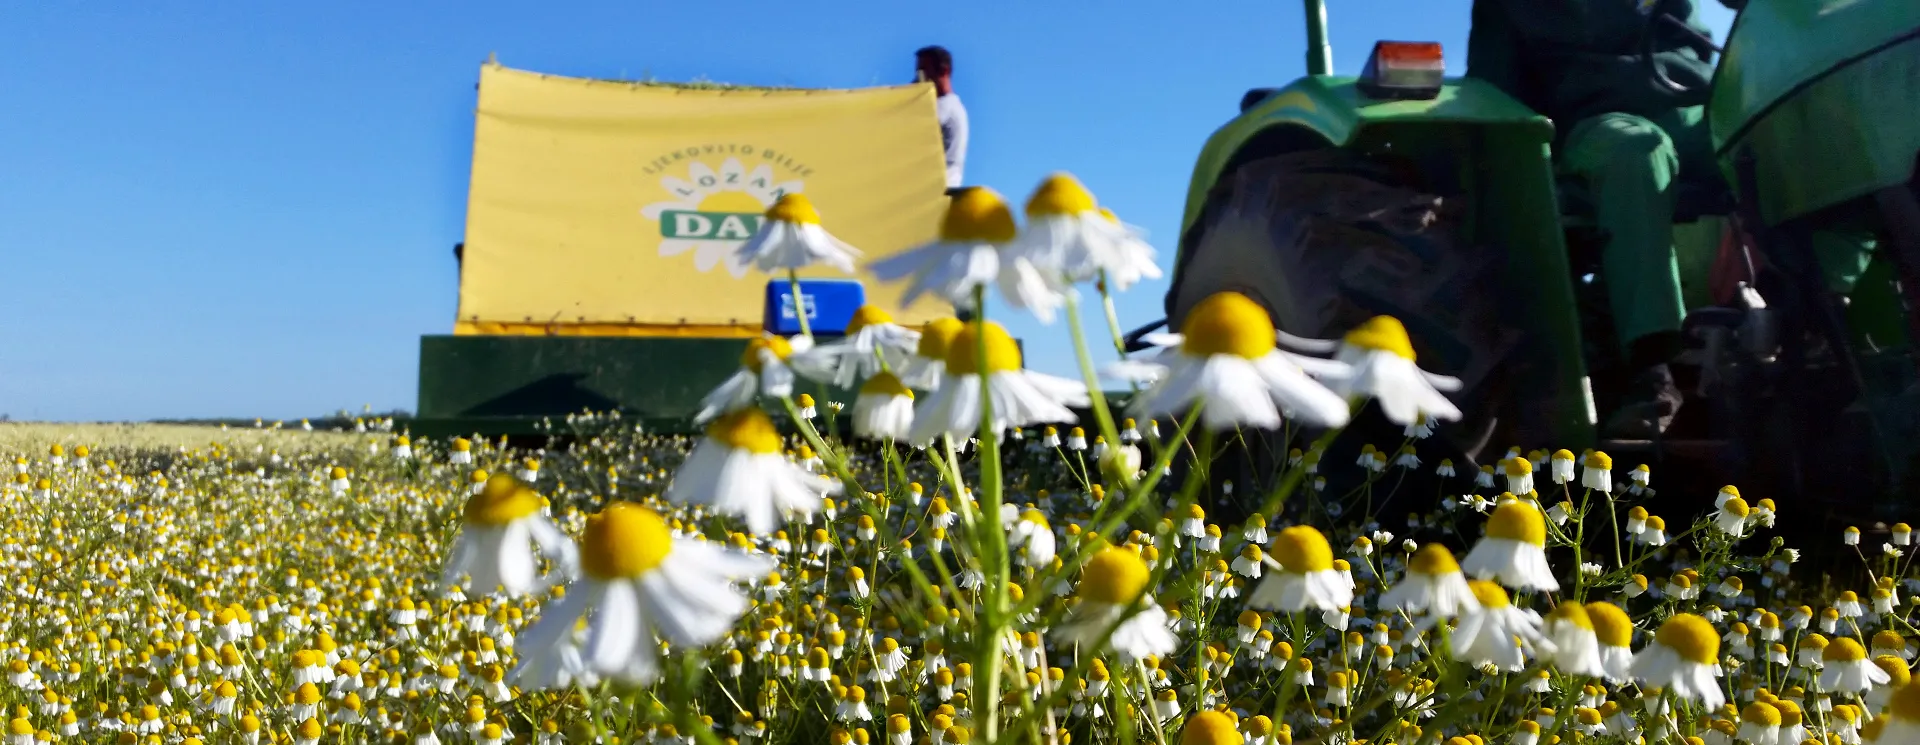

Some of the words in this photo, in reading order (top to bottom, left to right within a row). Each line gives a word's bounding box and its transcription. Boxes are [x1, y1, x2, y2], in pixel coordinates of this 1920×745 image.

[642, 144, 754, 174] LJEKOVITO
[762, 148, 815, 177] BILJE
[674, 213, 767, 238] DA
